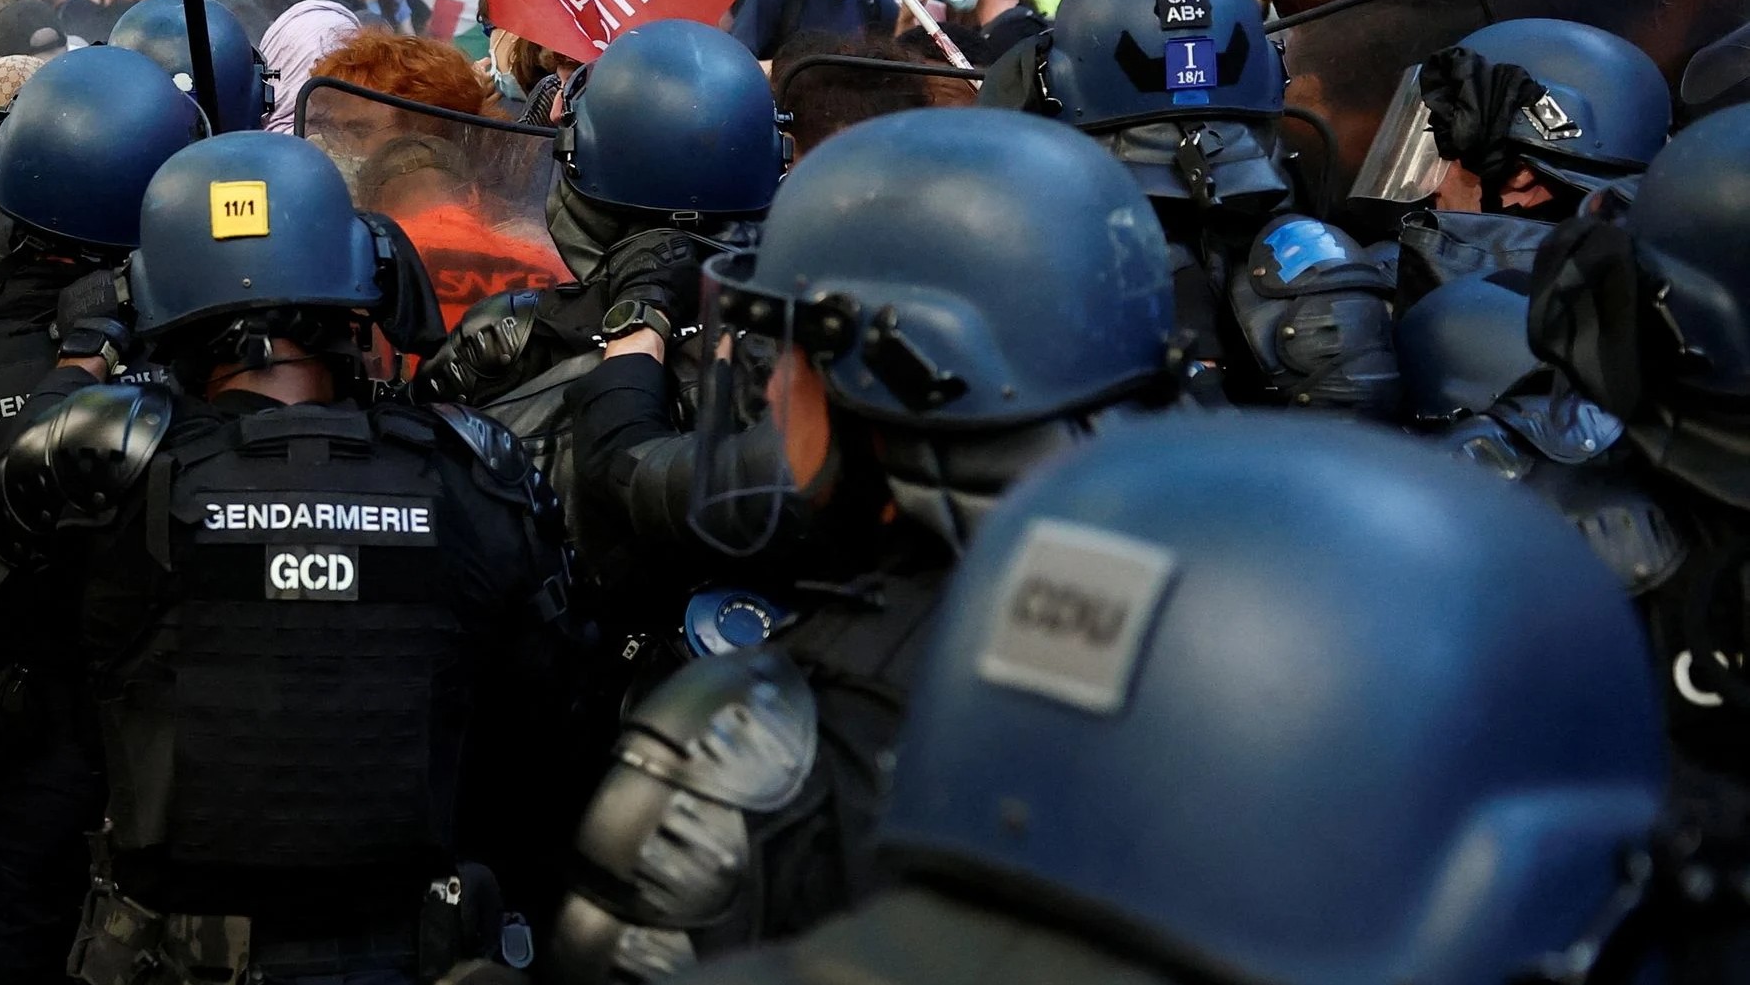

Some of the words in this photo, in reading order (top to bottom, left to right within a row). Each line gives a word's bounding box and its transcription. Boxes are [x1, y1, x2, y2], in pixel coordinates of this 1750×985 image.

[1166, 5, 1205, 23] AB+
[1184, 42, 1197, 69] I
[1177, 71, 1206, 85] 18/1
[224, 200, 254, 217] 11/1
[204, 503, 431, 533] GENDARMERIE
[269, 553, 355, 591] GCD
